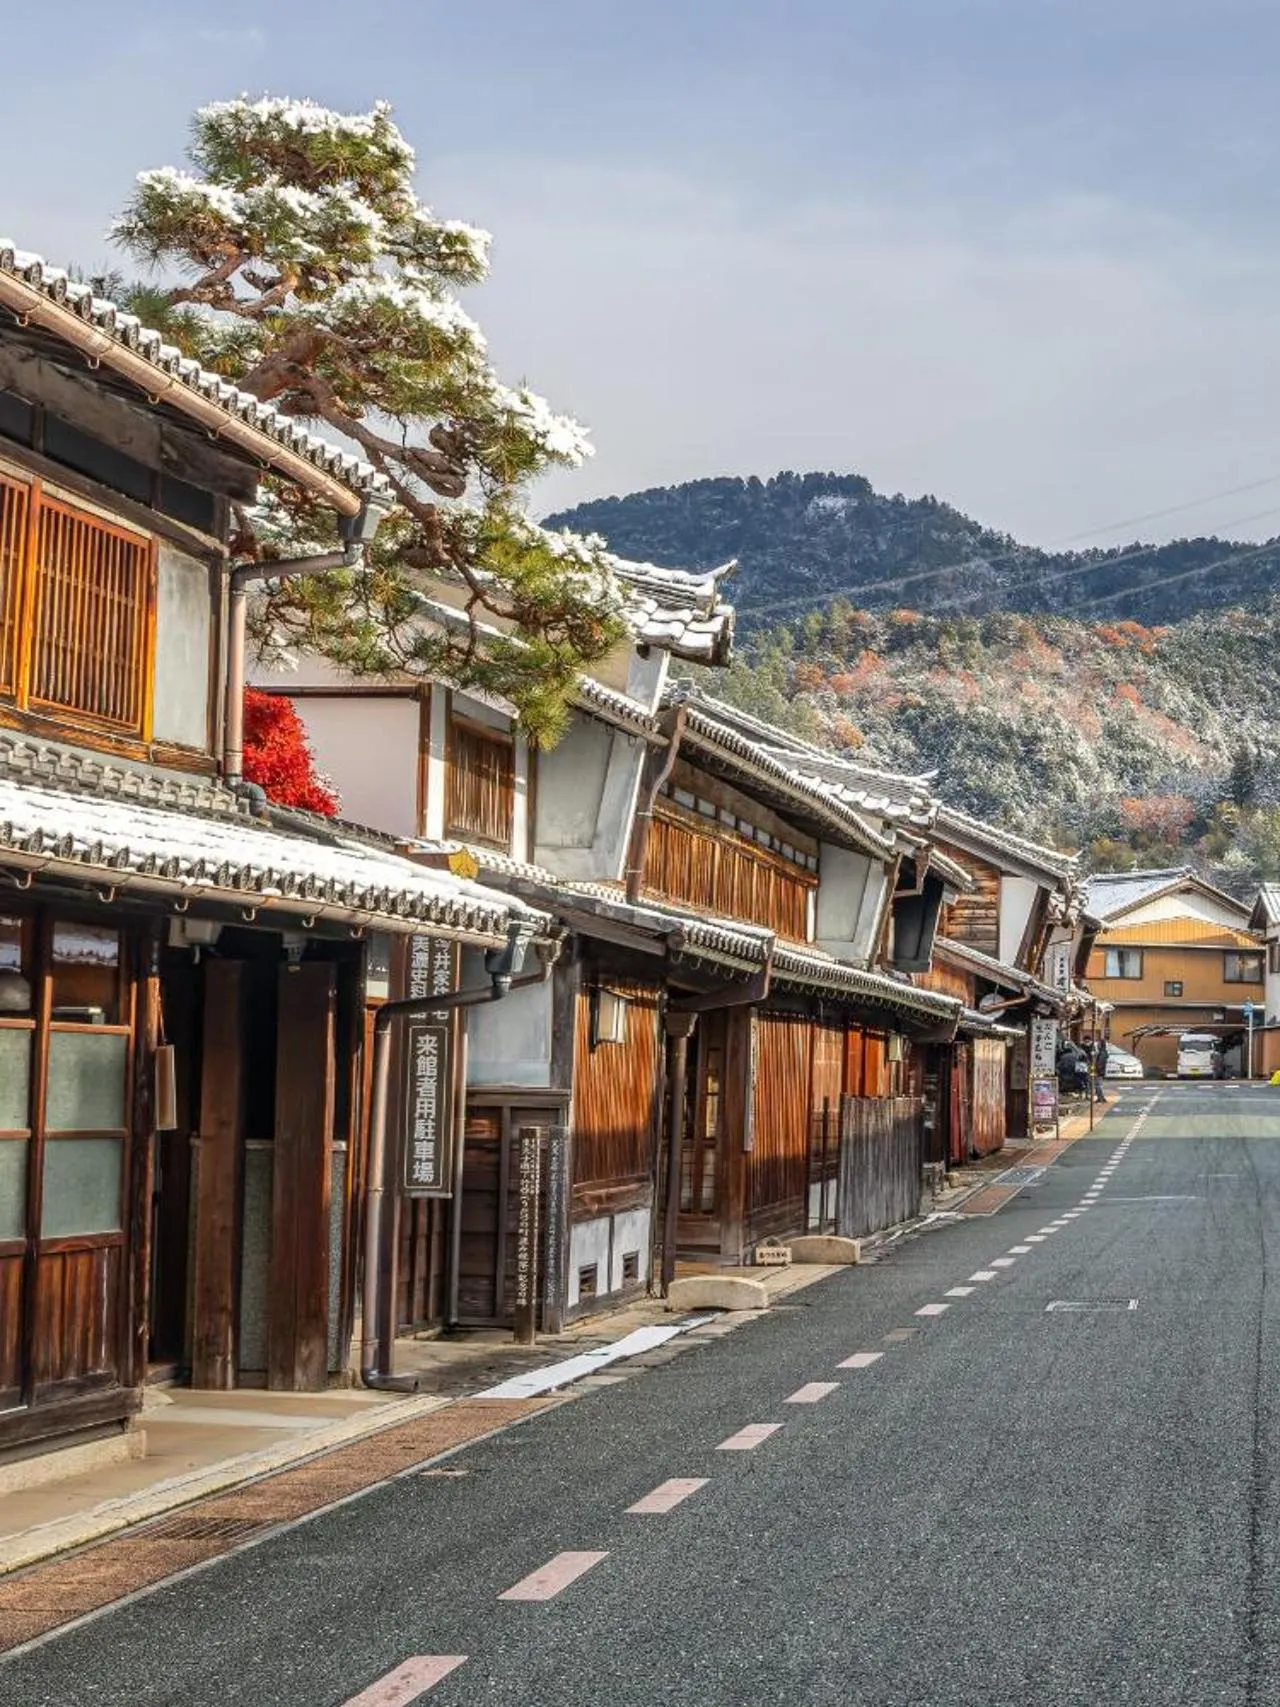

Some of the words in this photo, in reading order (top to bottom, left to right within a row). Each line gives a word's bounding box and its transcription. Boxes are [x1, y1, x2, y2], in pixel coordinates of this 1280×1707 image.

[412, 1034, 438, 1182] 来館者用駐車場
